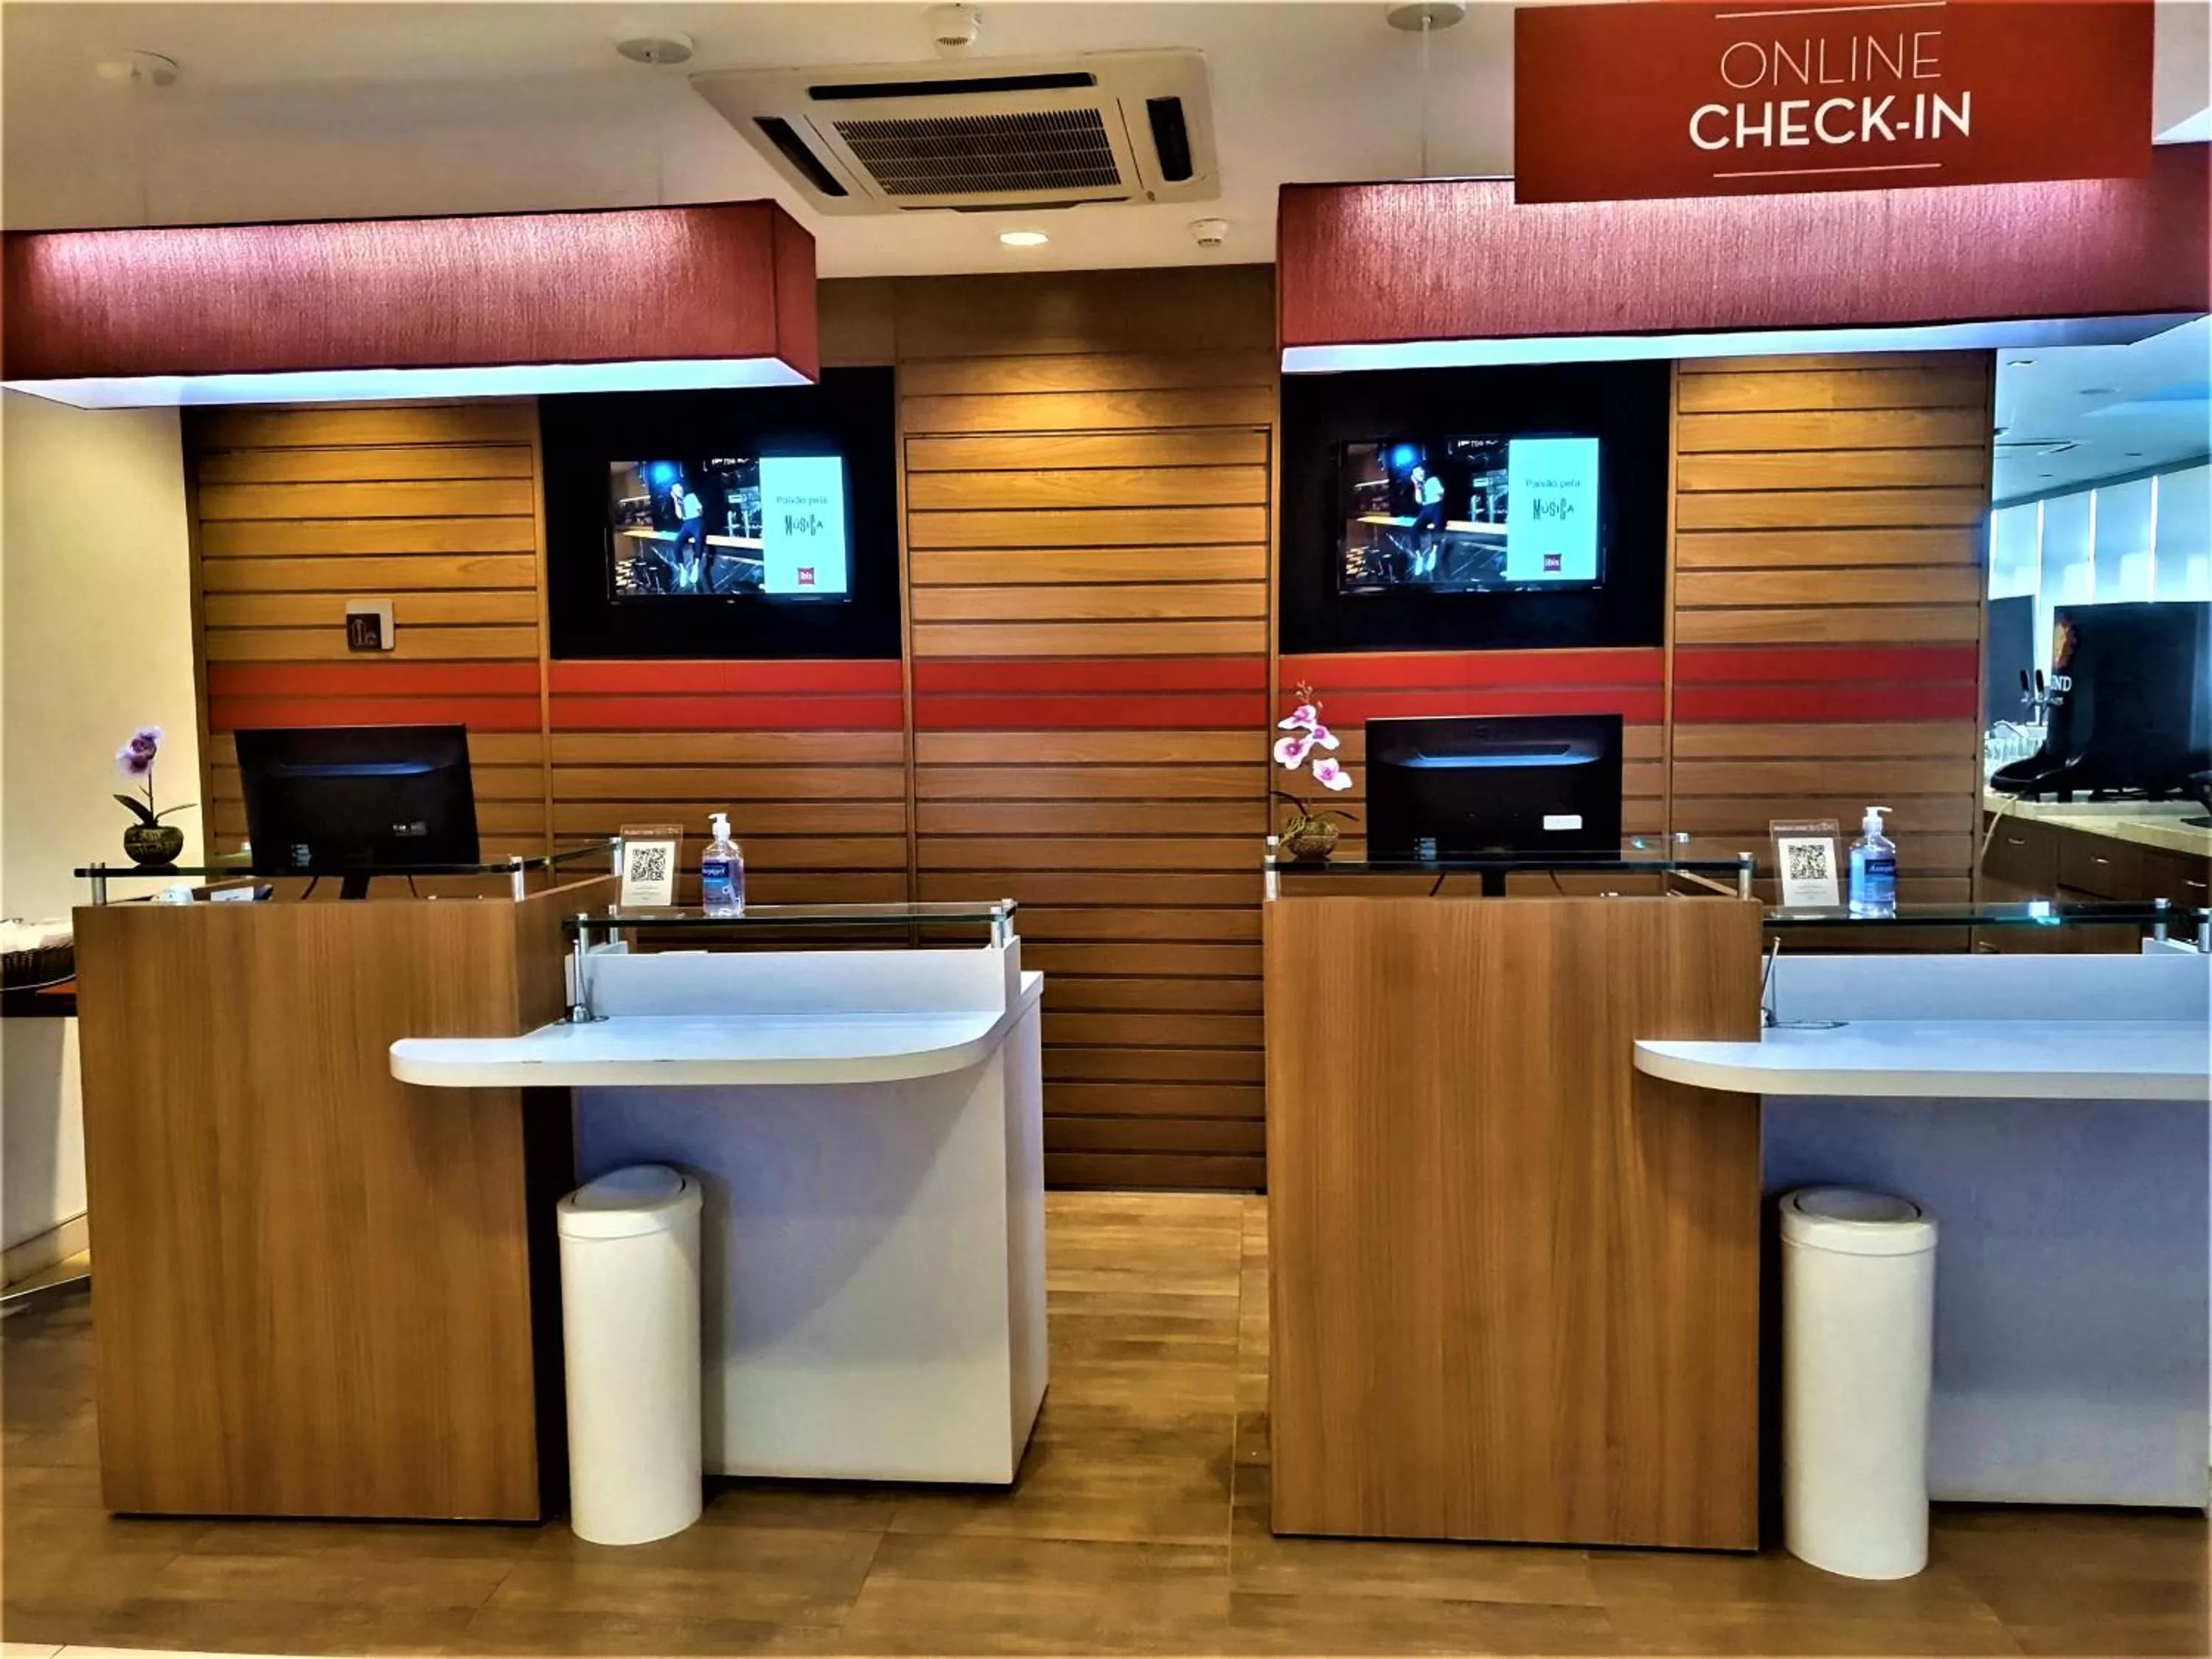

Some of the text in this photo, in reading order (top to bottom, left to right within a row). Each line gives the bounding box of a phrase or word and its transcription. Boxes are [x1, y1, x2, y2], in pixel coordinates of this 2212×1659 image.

[1720, 31, 1943, 88] ONLINE
[1688, 91, 1972, 150] CHECK-IN
[2049, 675, 2072, 692] ND
